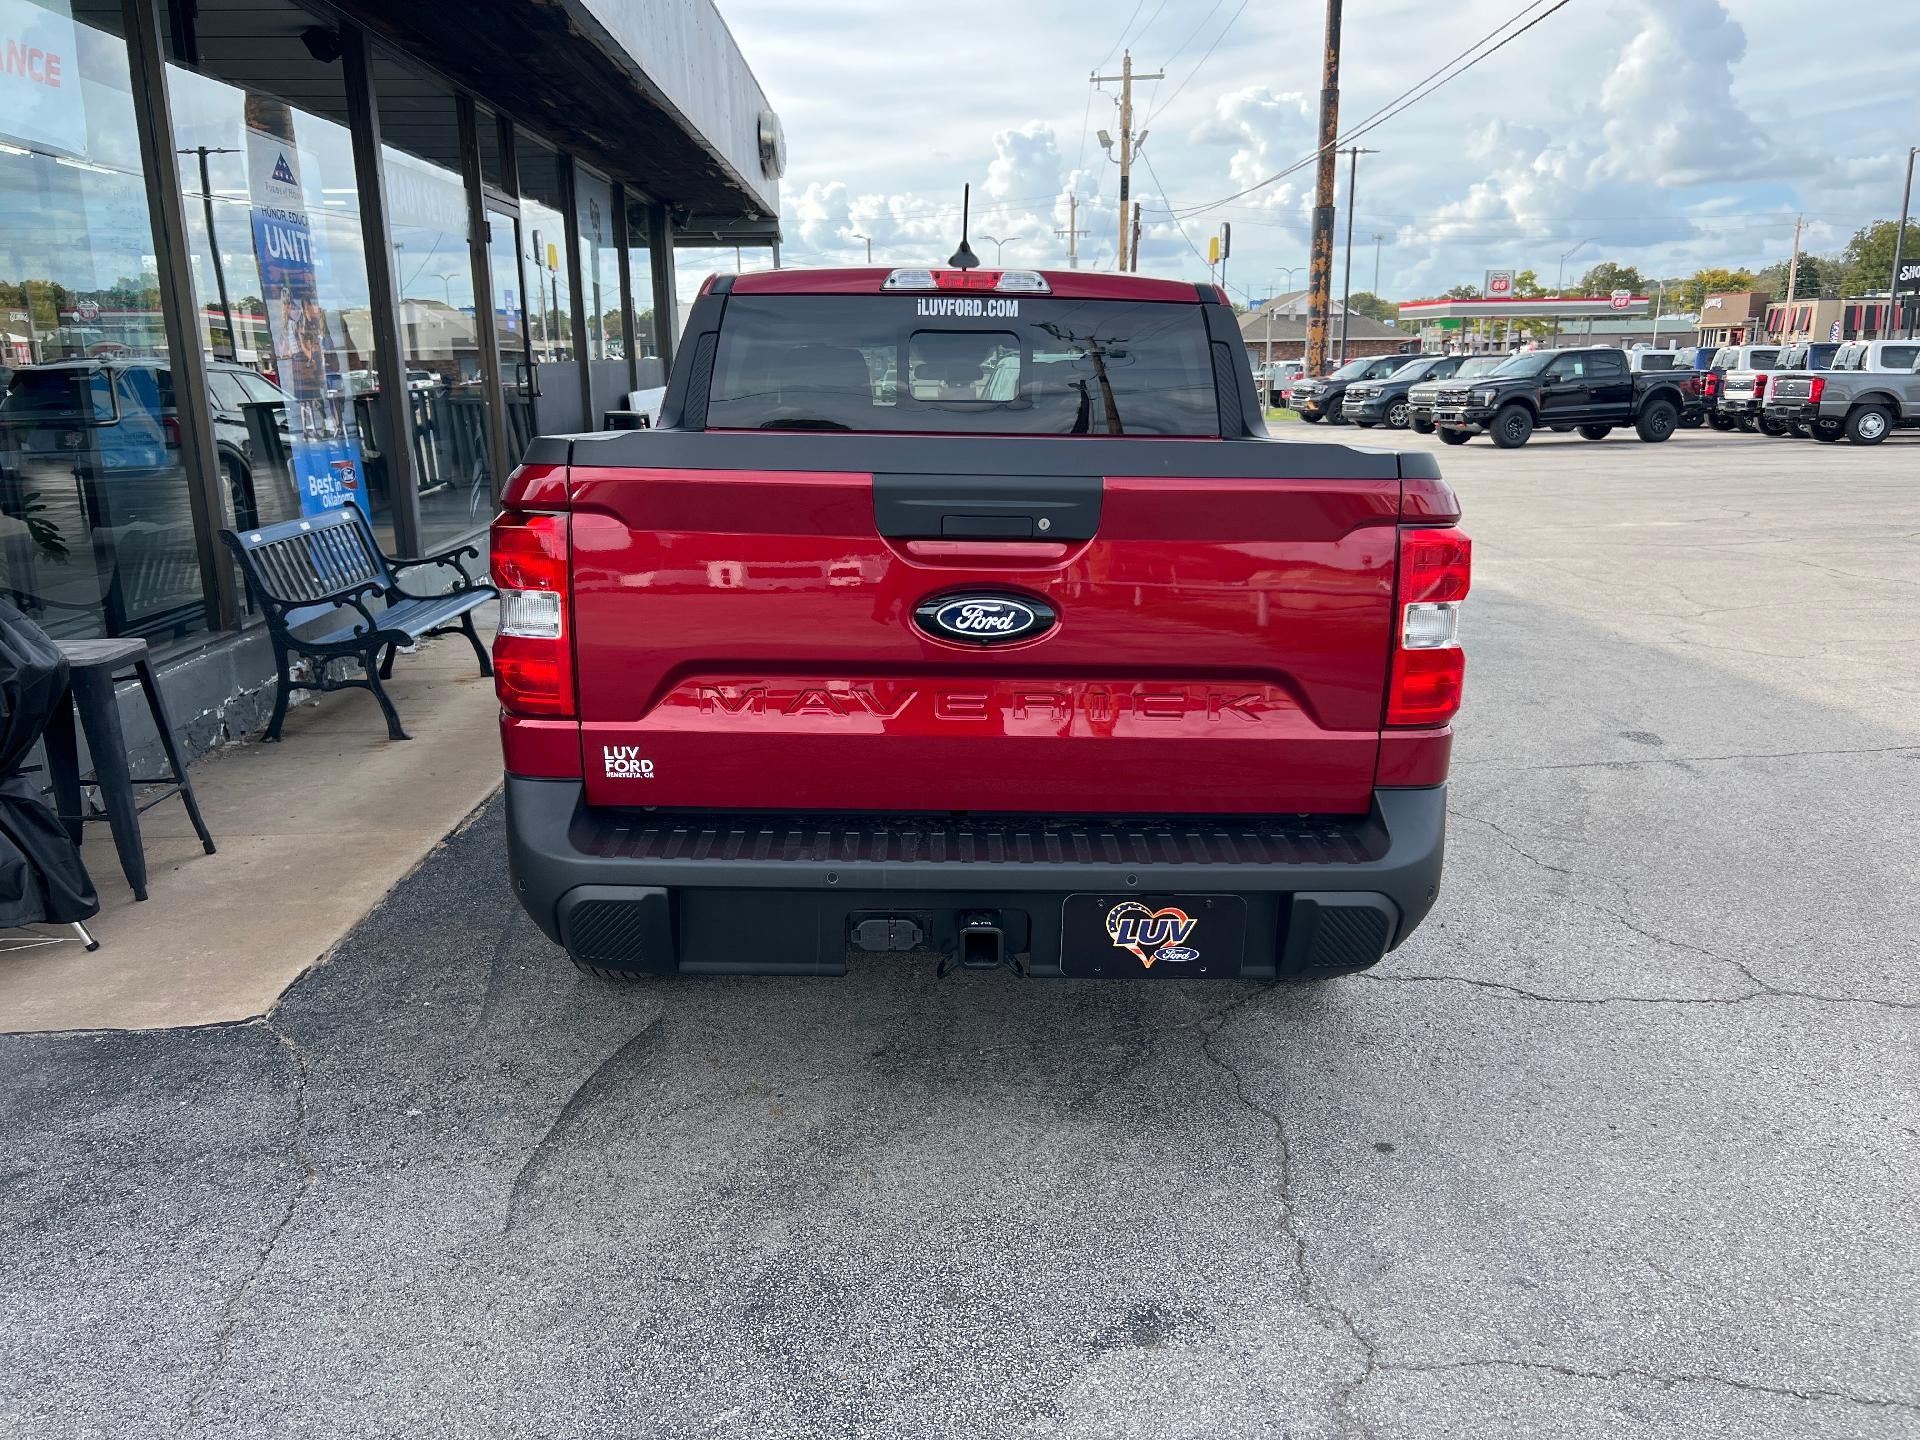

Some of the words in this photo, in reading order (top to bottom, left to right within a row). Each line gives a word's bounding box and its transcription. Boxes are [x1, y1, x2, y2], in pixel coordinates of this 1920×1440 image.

[0, 38, 61, 88] NCE
[917, 298, 1019, 318] iLUVFORD.COM
[308, 472, 335, 497] Best
[334, 478, 342, 492] in
[955, 604, 1016, 630] Ford
[698, 686, 1263, 722] MAVERICK
[603, 745, 640, 760] LUV
[604, 759, 654, 773] FORD
[1113, 919, 1198, 946] LUV
[1162, 949, 1190, 960] Ford
